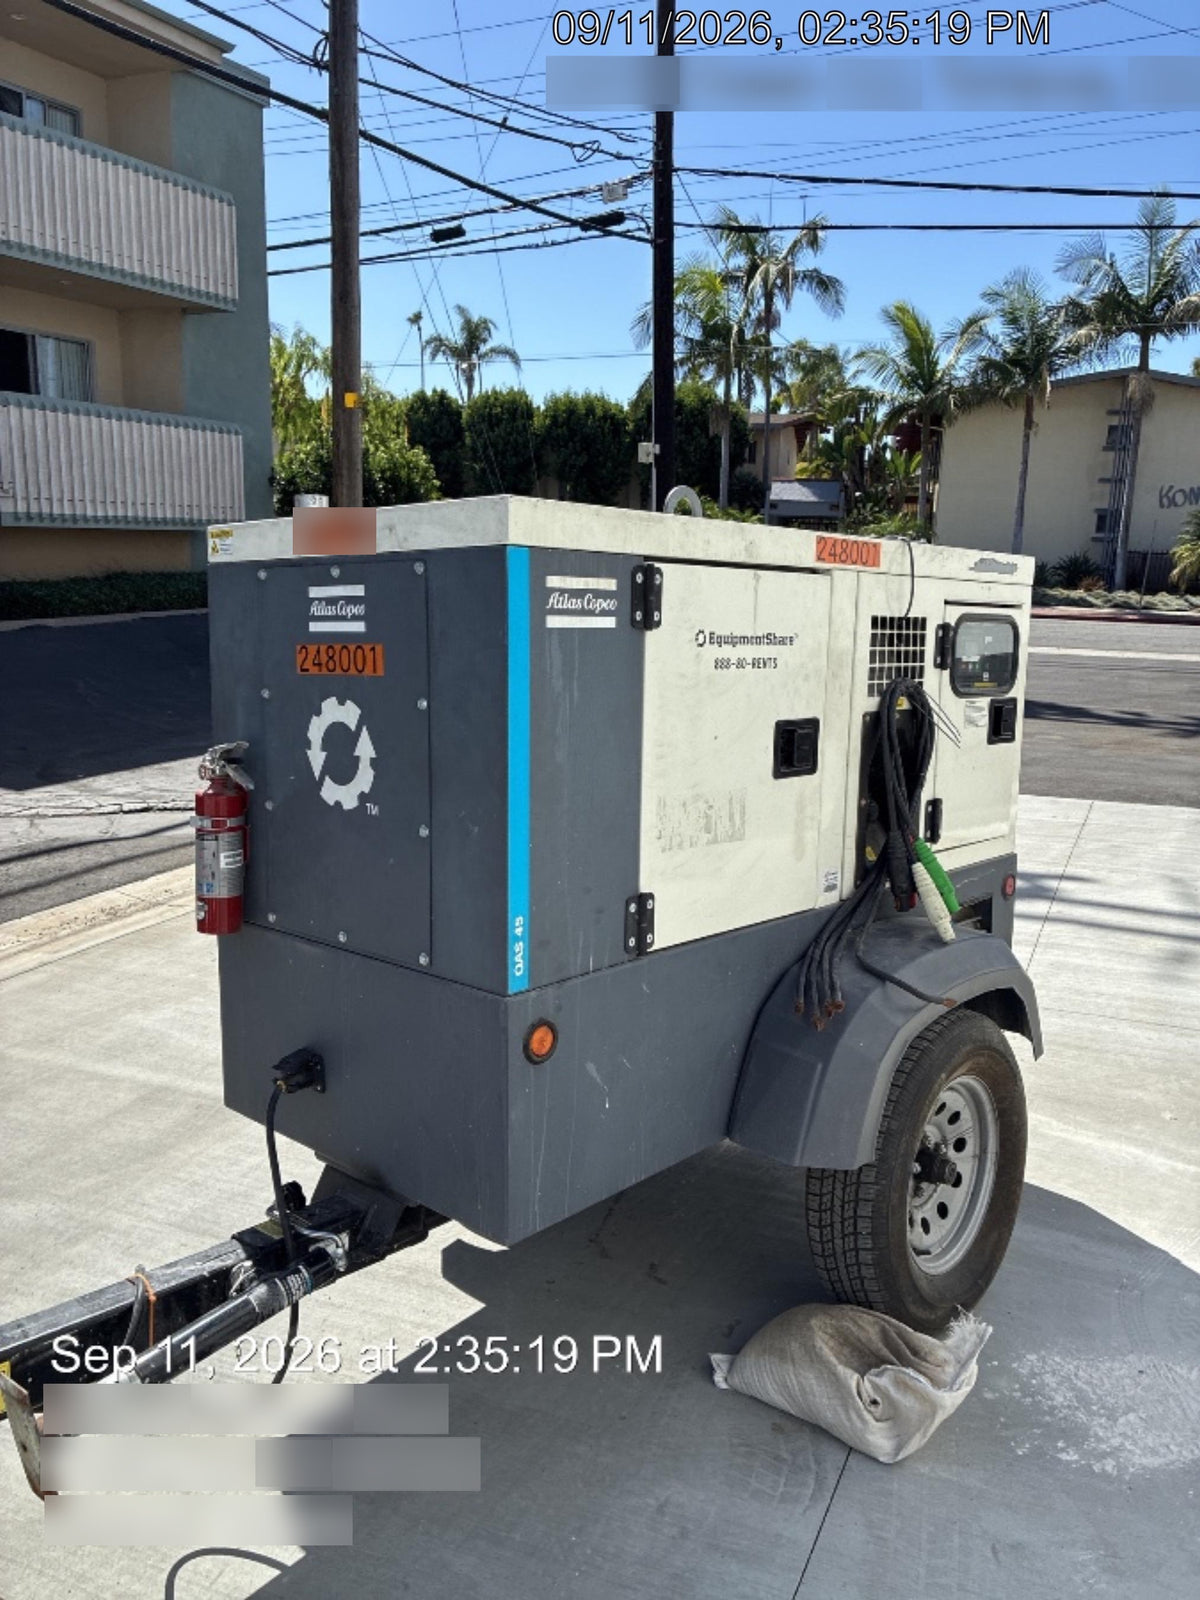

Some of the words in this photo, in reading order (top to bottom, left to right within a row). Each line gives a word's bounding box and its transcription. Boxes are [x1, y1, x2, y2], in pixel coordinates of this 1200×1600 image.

[816, 536, 879, 567] 248001
[308, 600, 337, 616] Atlas
[337, 600, 366, 619] Copco
[545, 591, 581, 610] Atlas
[583, 593, 617, 614] Copco
[297, 644, 377, 674] 248001
